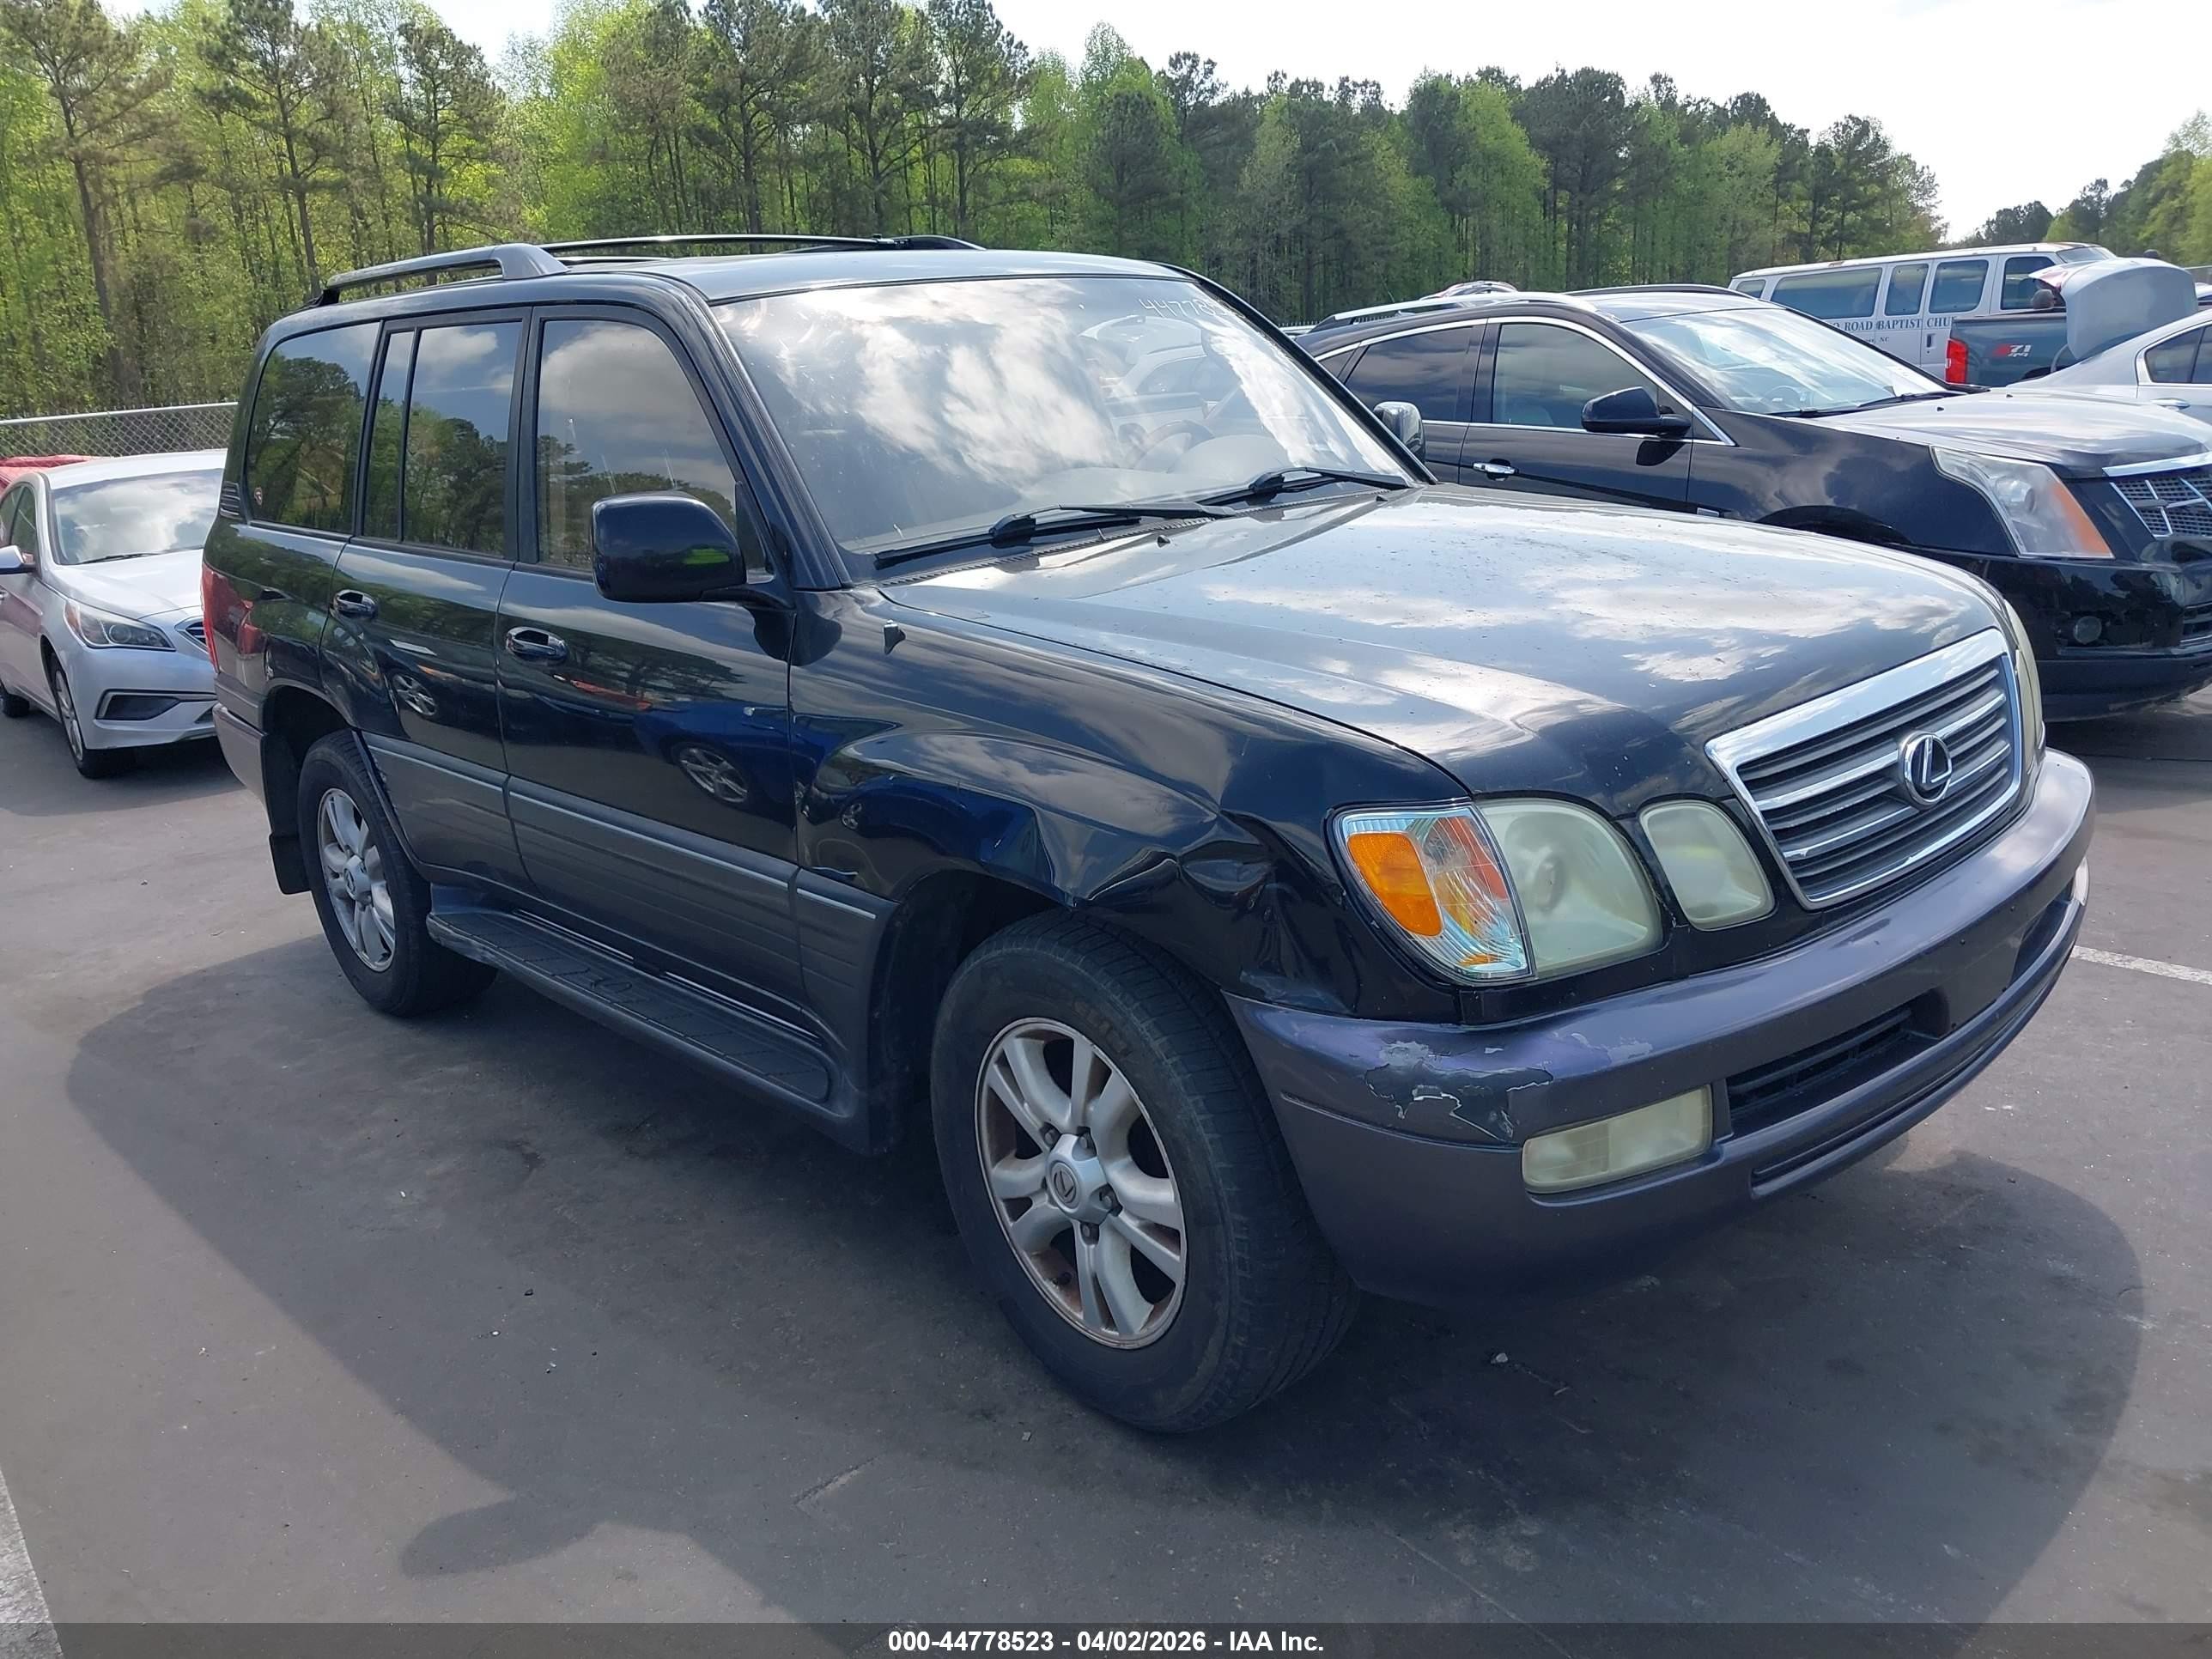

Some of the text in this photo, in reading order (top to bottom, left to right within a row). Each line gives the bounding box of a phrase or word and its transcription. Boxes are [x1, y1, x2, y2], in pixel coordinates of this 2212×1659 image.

[1138, 297, 1228, 318] 44778
[1844, 320, 1873, 331] ROAD
[1876, 319, 1923, 331] BAPTIST
